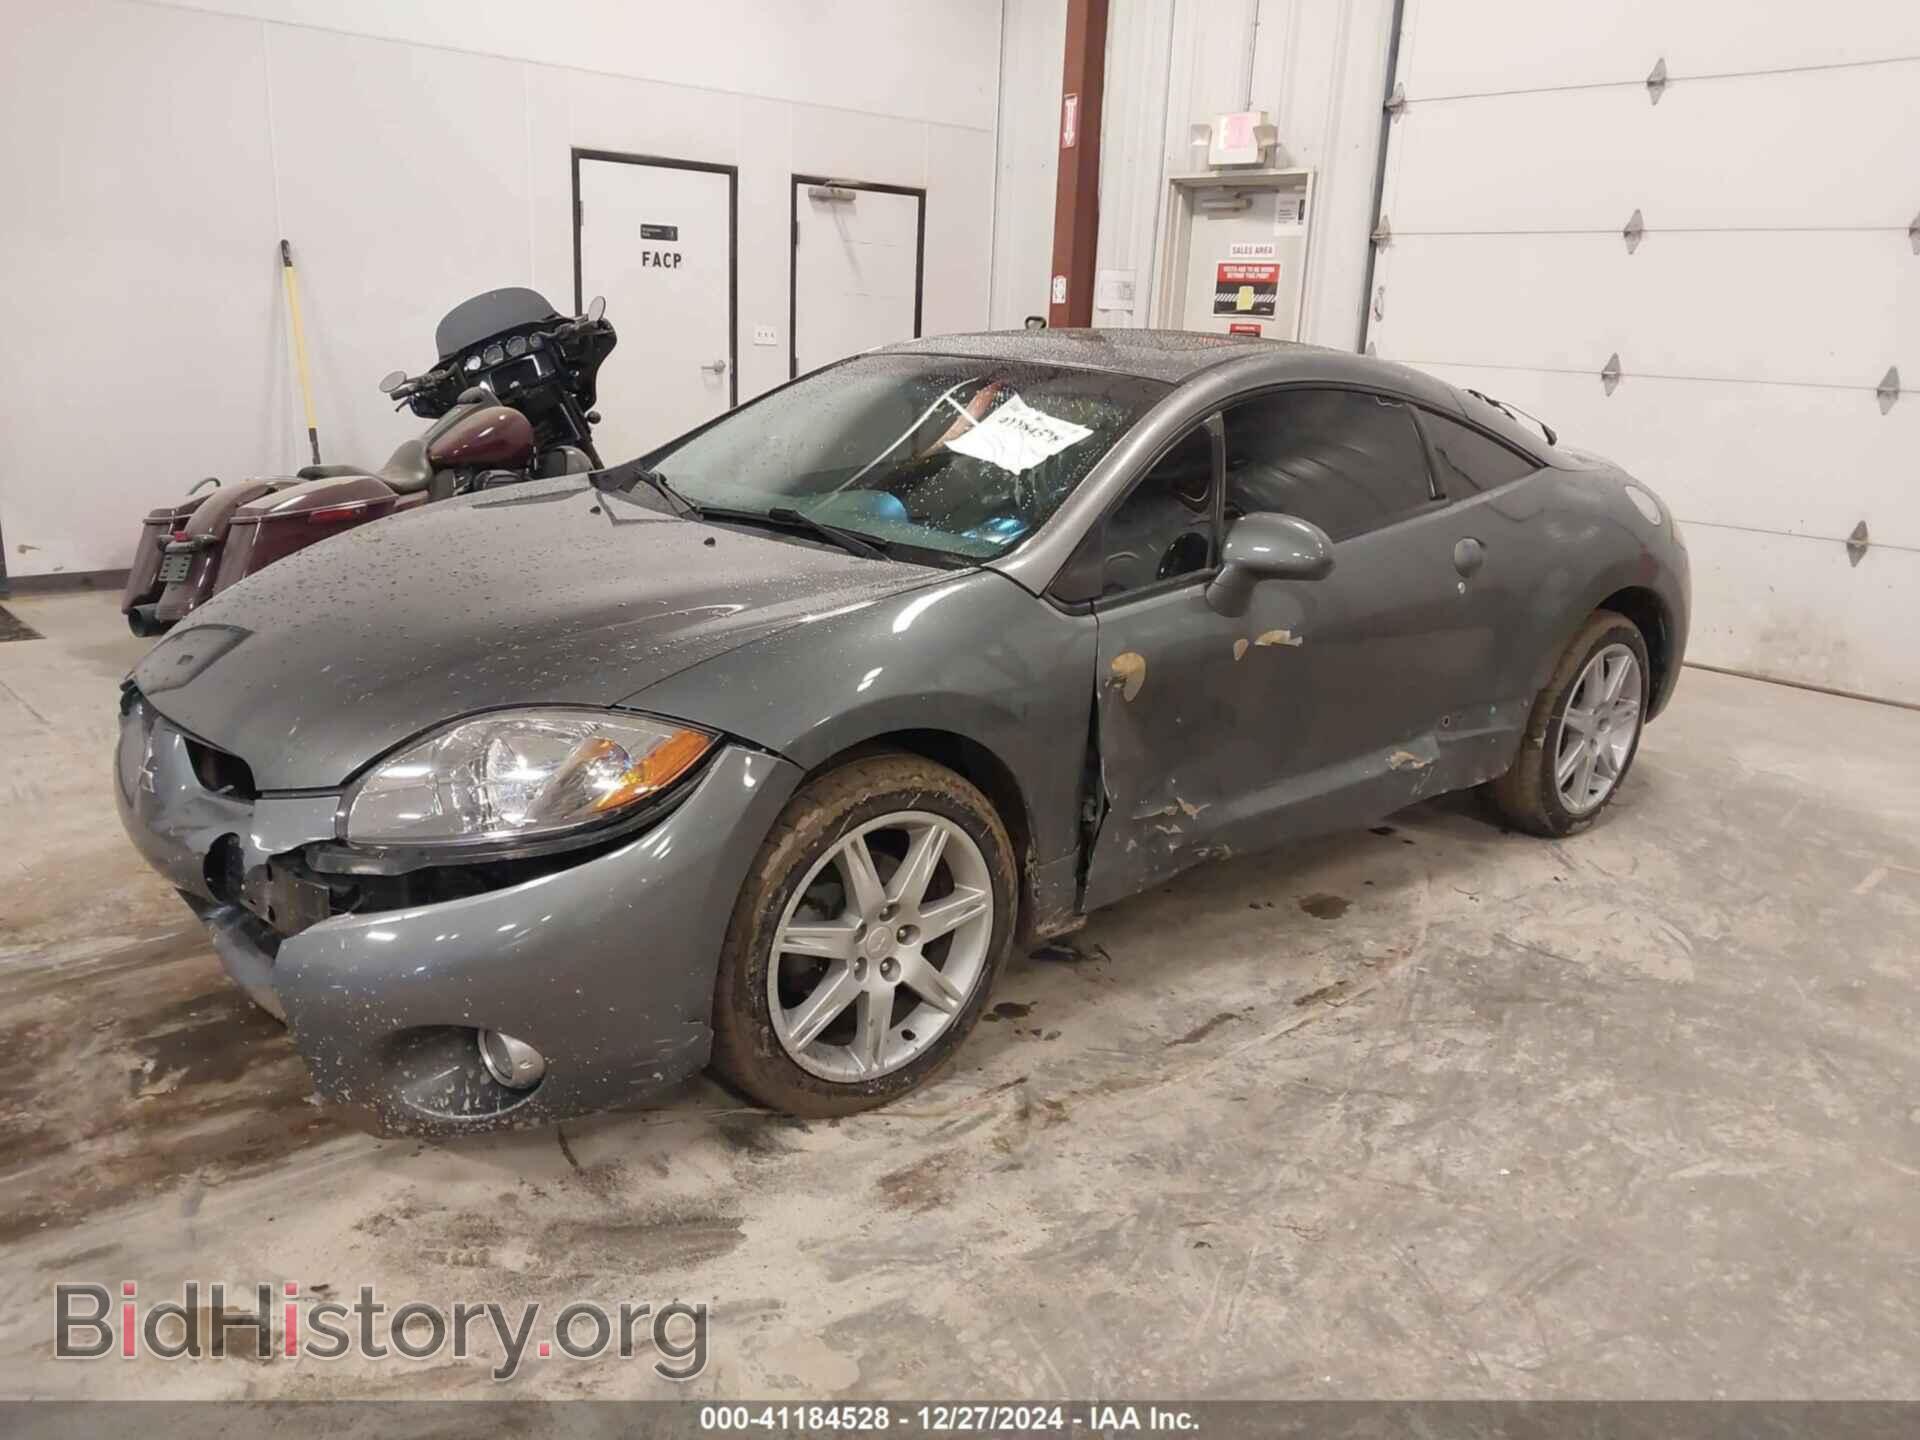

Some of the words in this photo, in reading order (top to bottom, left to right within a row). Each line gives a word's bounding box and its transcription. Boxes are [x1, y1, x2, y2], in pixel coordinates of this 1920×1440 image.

[1232, 246, 1253, 255] SALES
[1255, 246, 1273, 255] AREA
[642, 251, 682, 269] FACP
